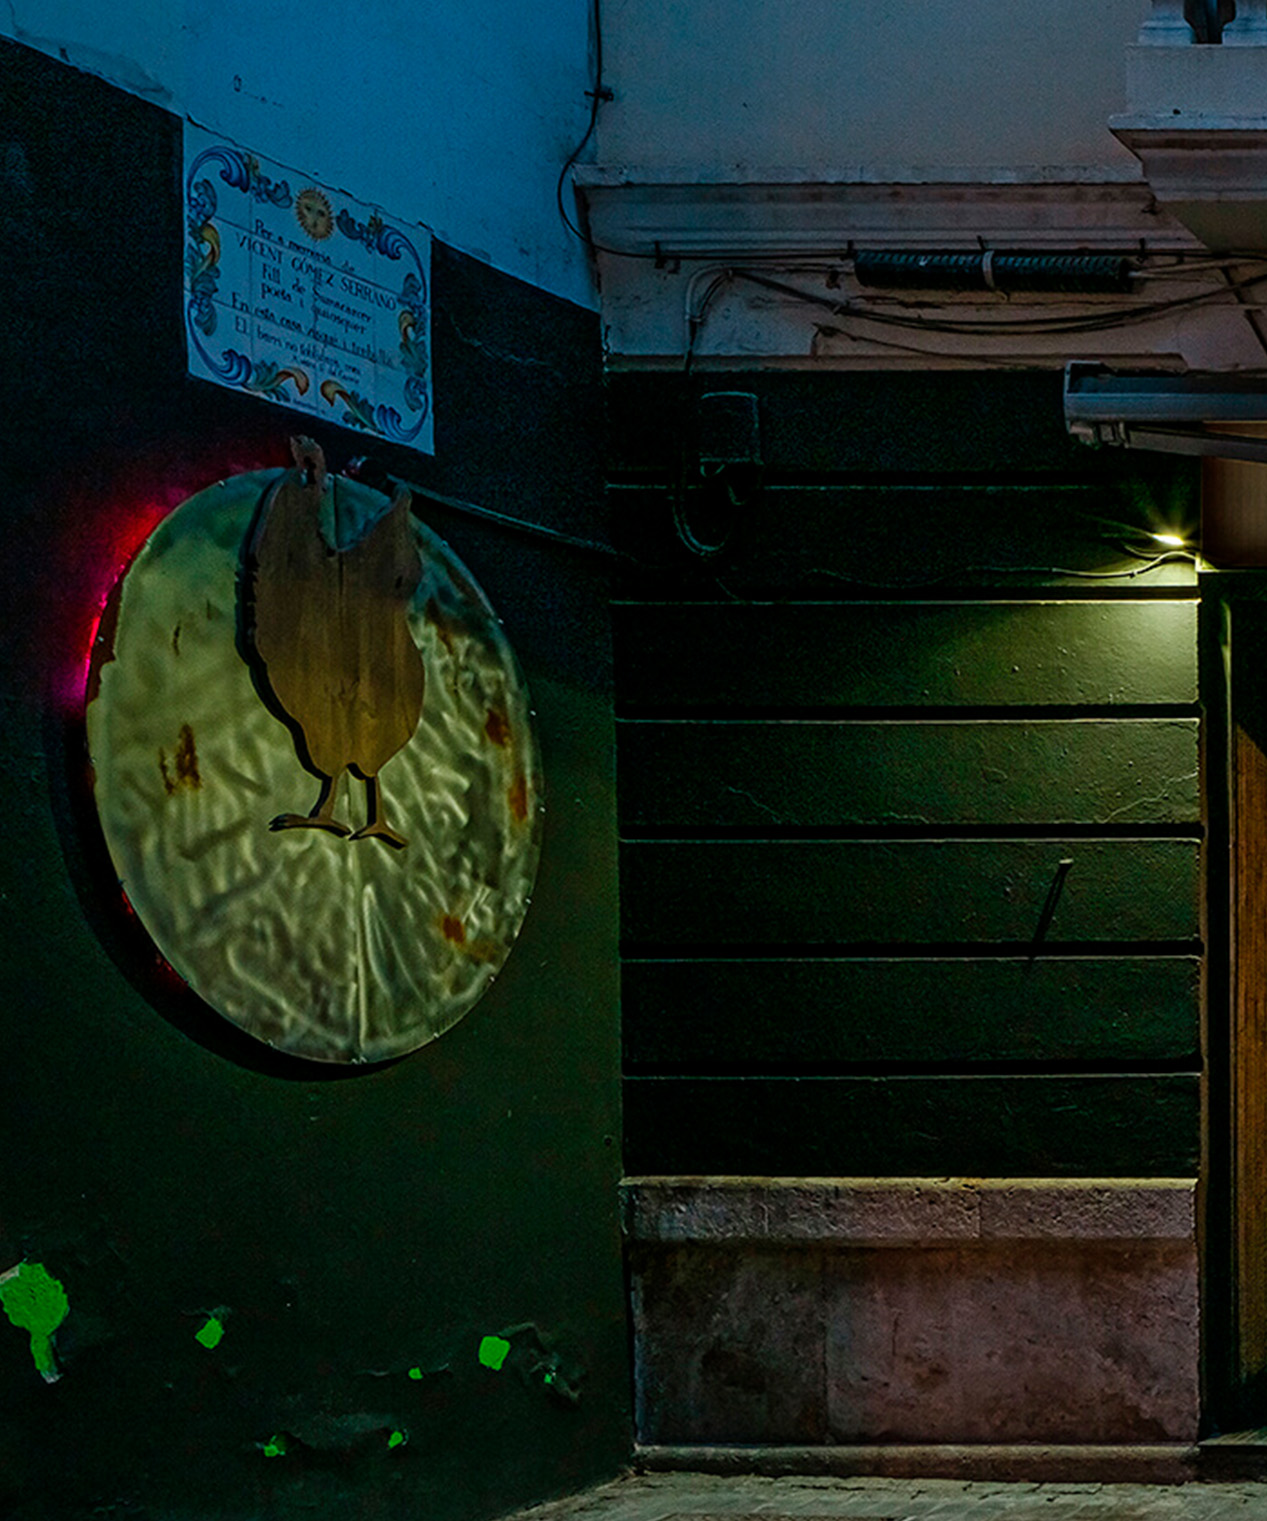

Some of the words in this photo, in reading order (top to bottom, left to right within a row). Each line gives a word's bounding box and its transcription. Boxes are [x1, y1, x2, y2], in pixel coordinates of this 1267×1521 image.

[236, 232, 282, 262] VICENT
[341, 277, 396, 311] SERRANO
[262, 284, 292, 303] poeta
[293, 278, 305, 293] de
[232, 293, 248, 312] En
[235, 316, 247, 333] El
